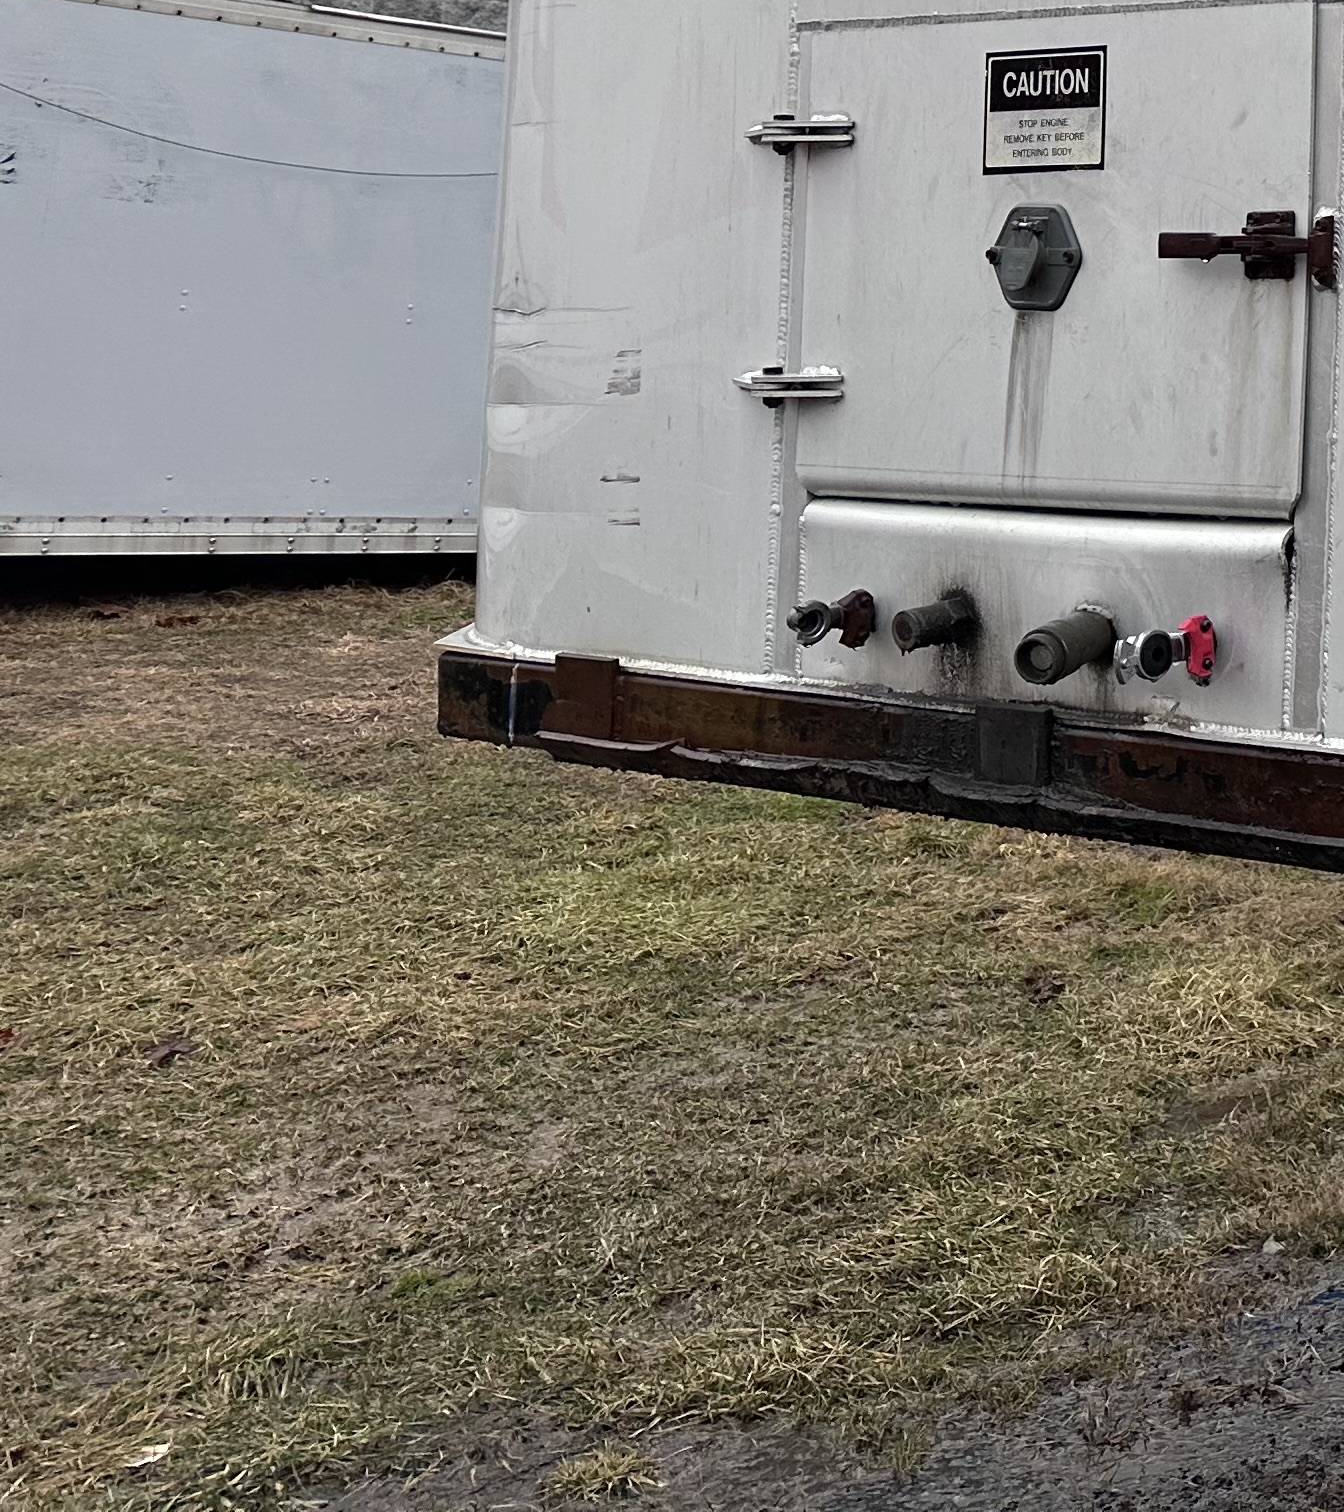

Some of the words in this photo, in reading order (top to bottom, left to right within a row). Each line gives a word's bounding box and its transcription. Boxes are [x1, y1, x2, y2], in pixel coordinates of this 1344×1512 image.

[1003, 68, 1089, 97] CAUTION
[1018, 119, 1037, 129] STOP
[1040, 118, 1070, 128] ENGINE
[1003, 134, 1034, 144] REMOVE
[1037, 133, 1052, 143] KEY
[1054, 131, 1085, 142] BEFORE
[1012, 147, 1049, 158] ENTERING
[1051, 147, 1073, 157] BODY
